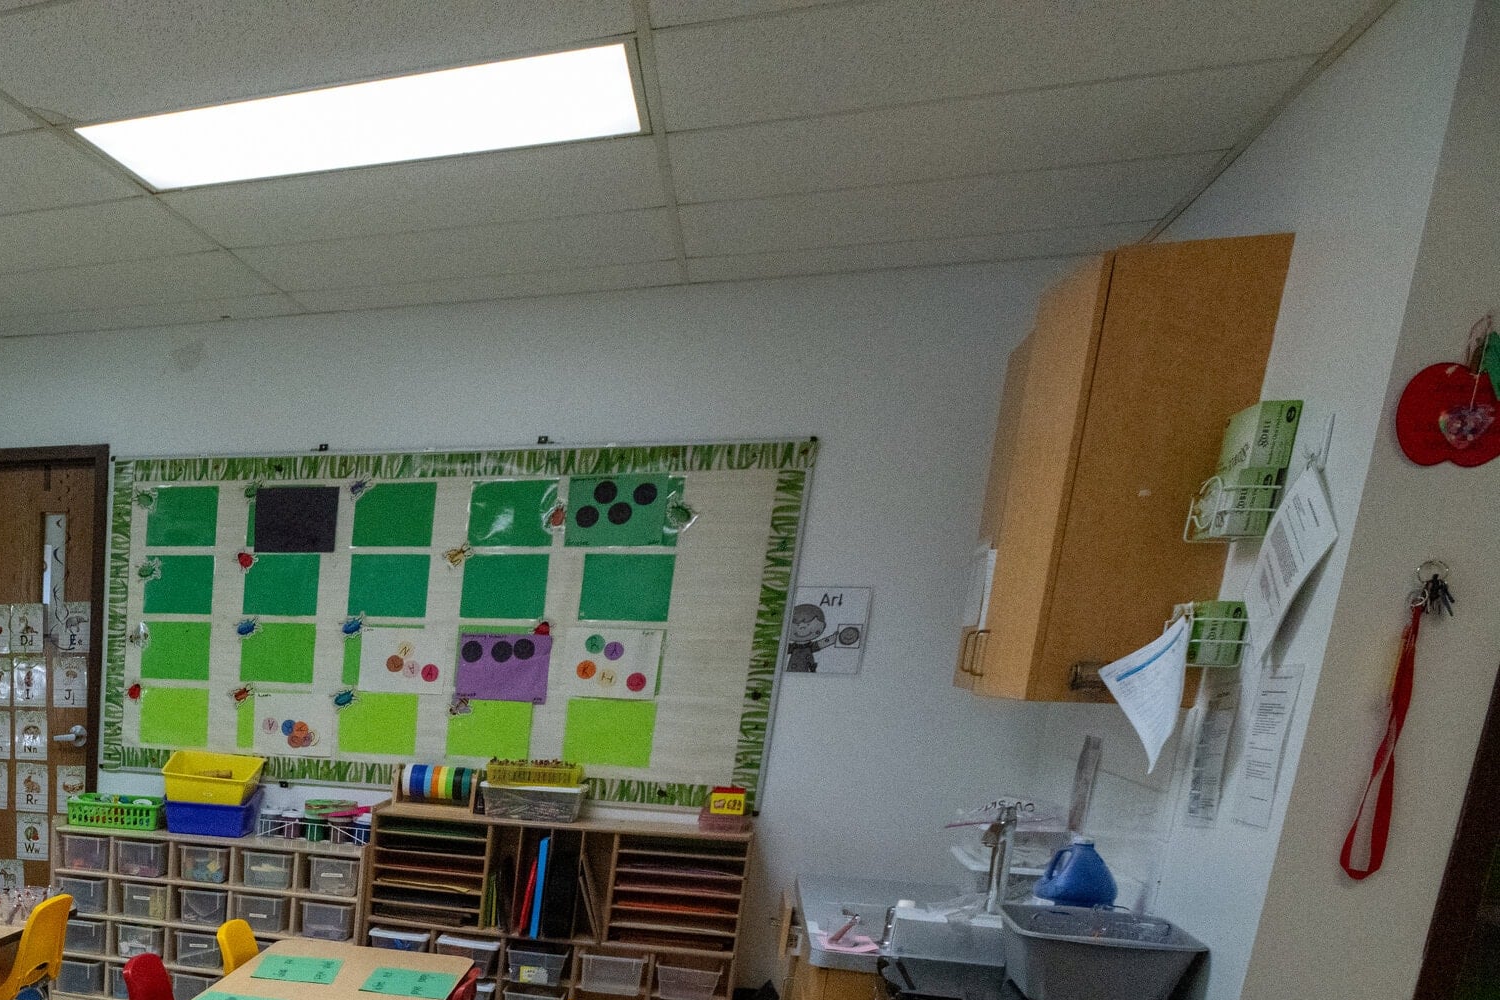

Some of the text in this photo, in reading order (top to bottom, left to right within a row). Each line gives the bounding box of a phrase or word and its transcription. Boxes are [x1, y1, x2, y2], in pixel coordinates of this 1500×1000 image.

[19, 635, 33, 646] Dd
[64, 689, 75, 705] Jj
[26, 794, 38, 805] Rr
[24, 842, 40, 854] Ww
